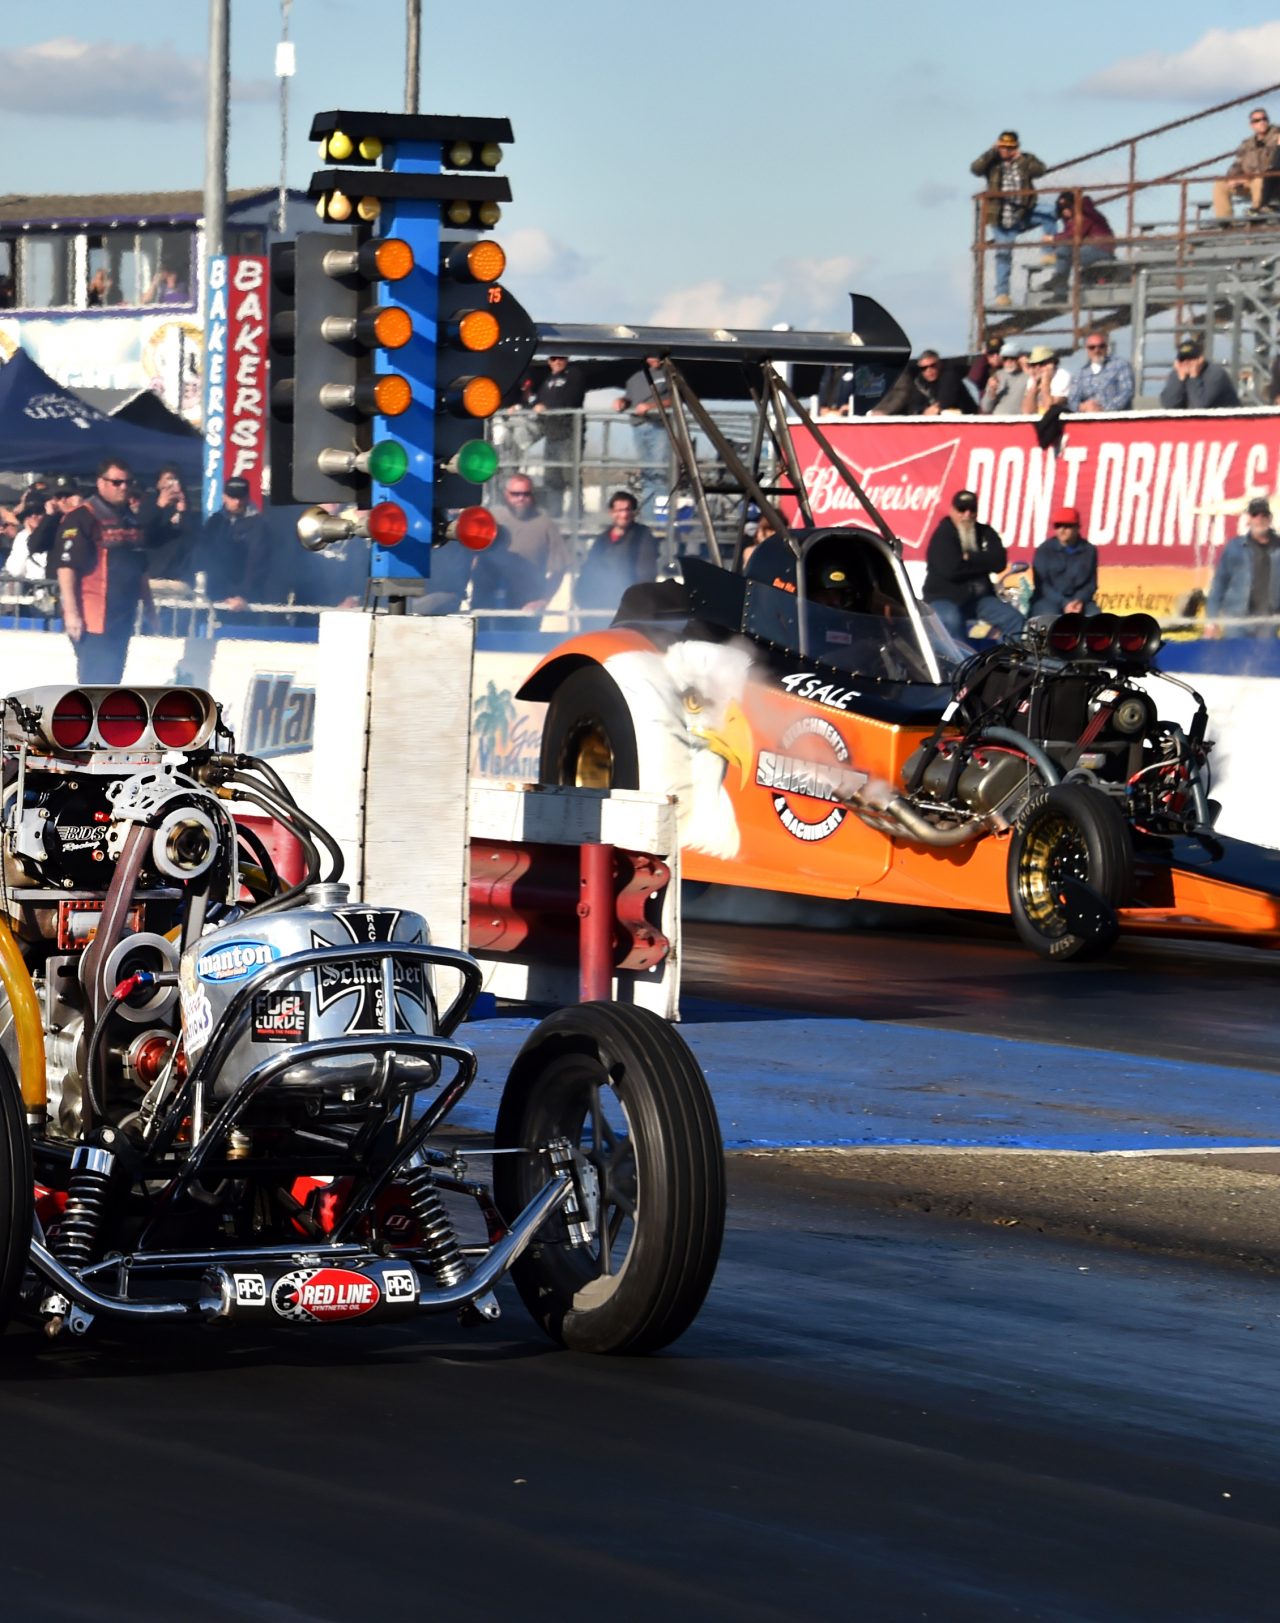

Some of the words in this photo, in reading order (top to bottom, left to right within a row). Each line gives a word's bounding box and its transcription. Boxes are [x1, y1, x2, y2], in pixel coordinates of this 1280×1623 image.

[1086, 440, 1239, 549] DRINK
[781, 673, 816, 692] 4
[798, 680, 861, 710] SALE
[779, 807, 843, 842] MACHINERY
[200, 945, 273, 976] manton
[256, 996, 305, 1016] FUEL
[256, 1015, 305, 1030] CURVE
[239, 1279, 263, 1299] PPG
[303, 1285, 333, 1306] RED
[339, 1283, 373, 1305] LINE
[387, 1275, 414, 1297] PPG
